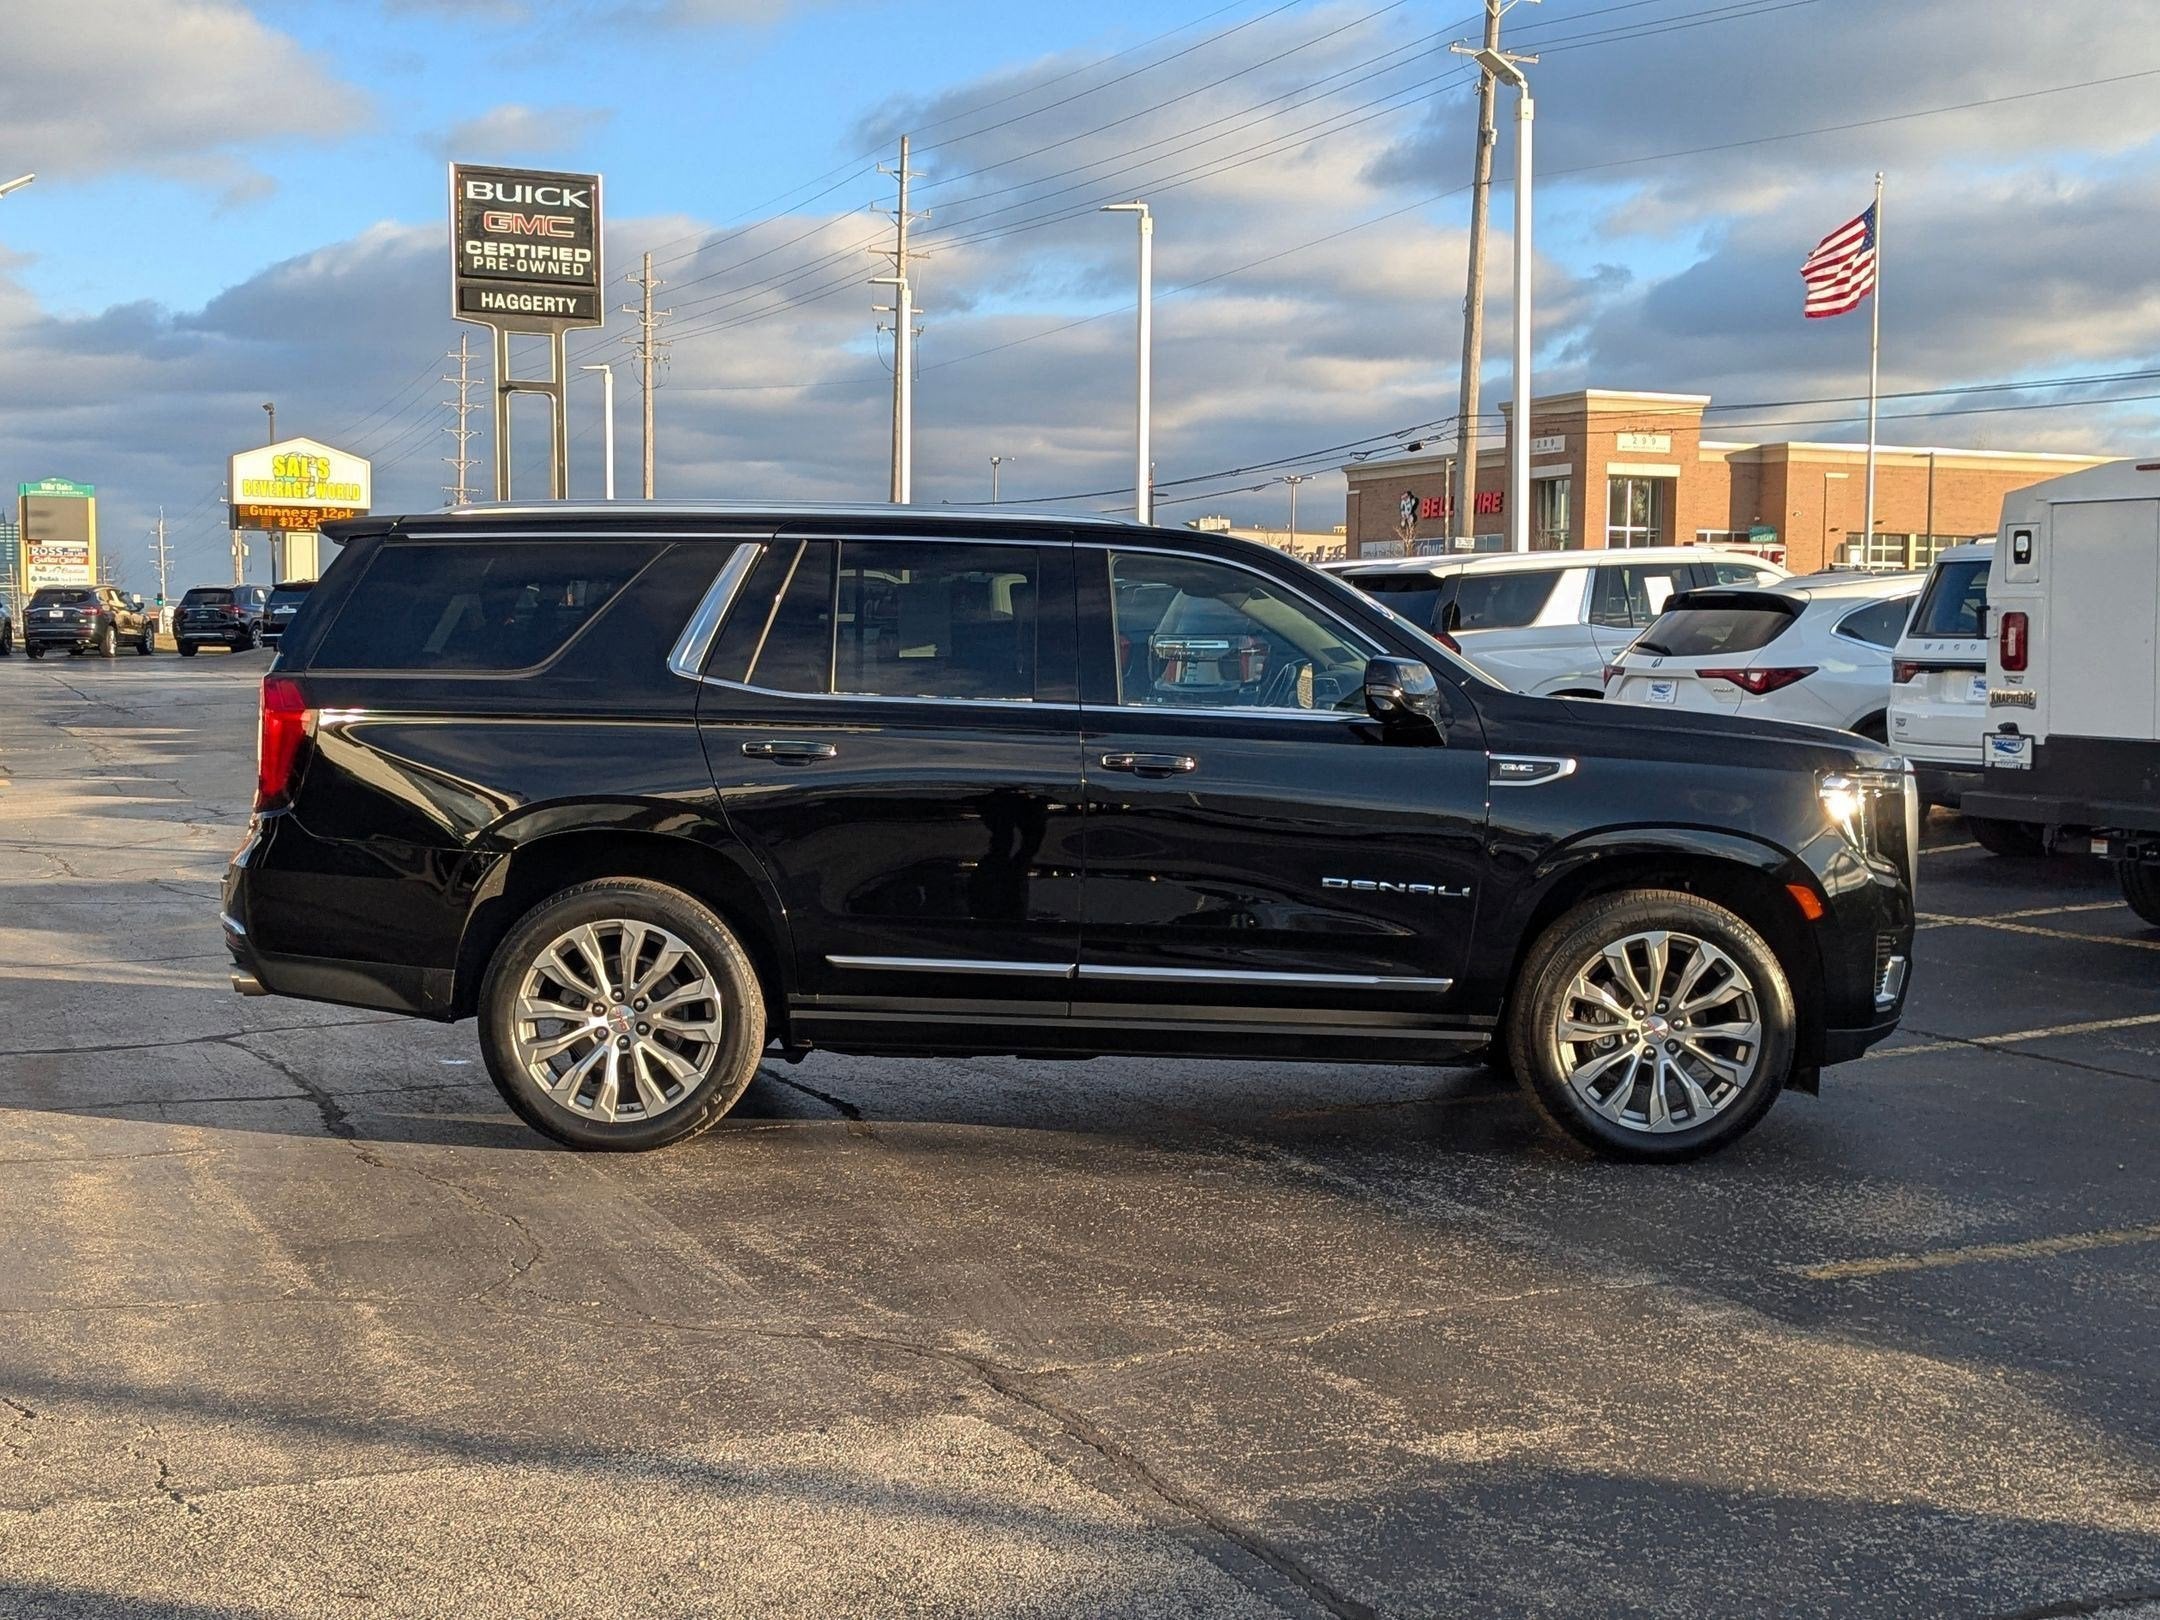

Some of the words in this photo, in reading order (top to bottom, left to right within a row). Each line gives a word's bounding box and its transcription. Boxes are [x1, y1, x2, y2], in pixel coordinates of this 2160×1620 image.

[466, 180, 590, 209] BUICK
[483, 210, 575, 239] GMC
[465, 240, 592, 263] CERTIFIED
[473, 256, 585, 276] PRE-OWNED
[481, 292, 577, 313] HAGGERTY
[273, 455, 330, 479] SAL'S
[243, 479, 311, 498] BEVERAGE
[315, 481, 361, 501] WORLD
[249, 505, 318, 518] Guinness
[322, 508, 355, 520] 12pk
[1420, 496, 1455, 519] BELL
[1475, 491, 1503, 514] IRE
[279, 517, 325, 528] $12.9
[31, 547, 64, 556] ROSS
[1924, 643, 1977, 651] WAGO
[1502, 763, 1534, 773] GMC
[1321, 876, 1471, 897] DENALI
